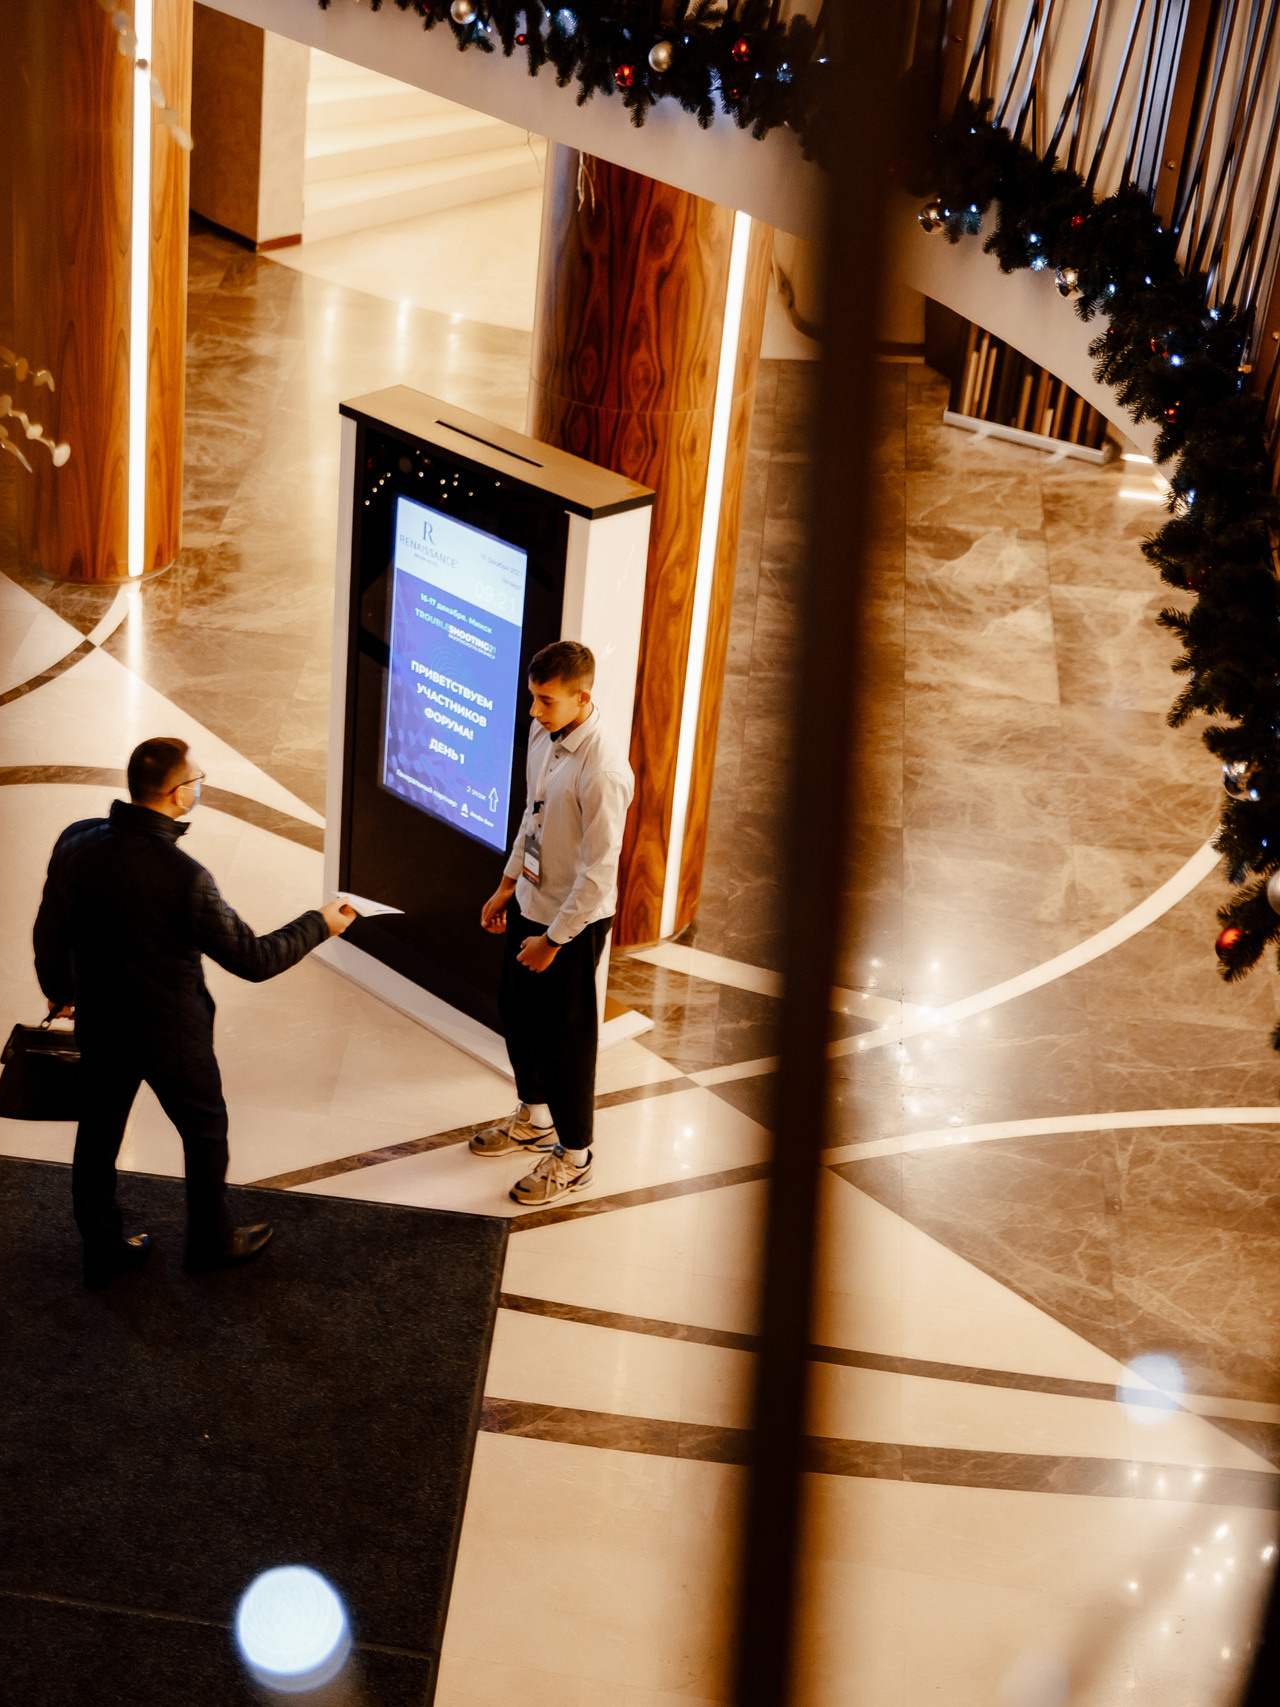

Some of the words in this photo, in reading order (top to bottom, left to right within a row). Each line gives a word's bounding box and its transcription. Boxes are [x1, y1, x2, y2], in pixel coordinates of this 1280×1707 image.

[422, 520, 437, 545] R
[410, 660, 493, 711] ПРИВЕТСТВУЕМ
[416, 683, 487, 727] УЧАСТНИКОВ
[424, 707, 474, 741] ФОРУМА!
[428, 738, 459, 761] ДЕНЬ
